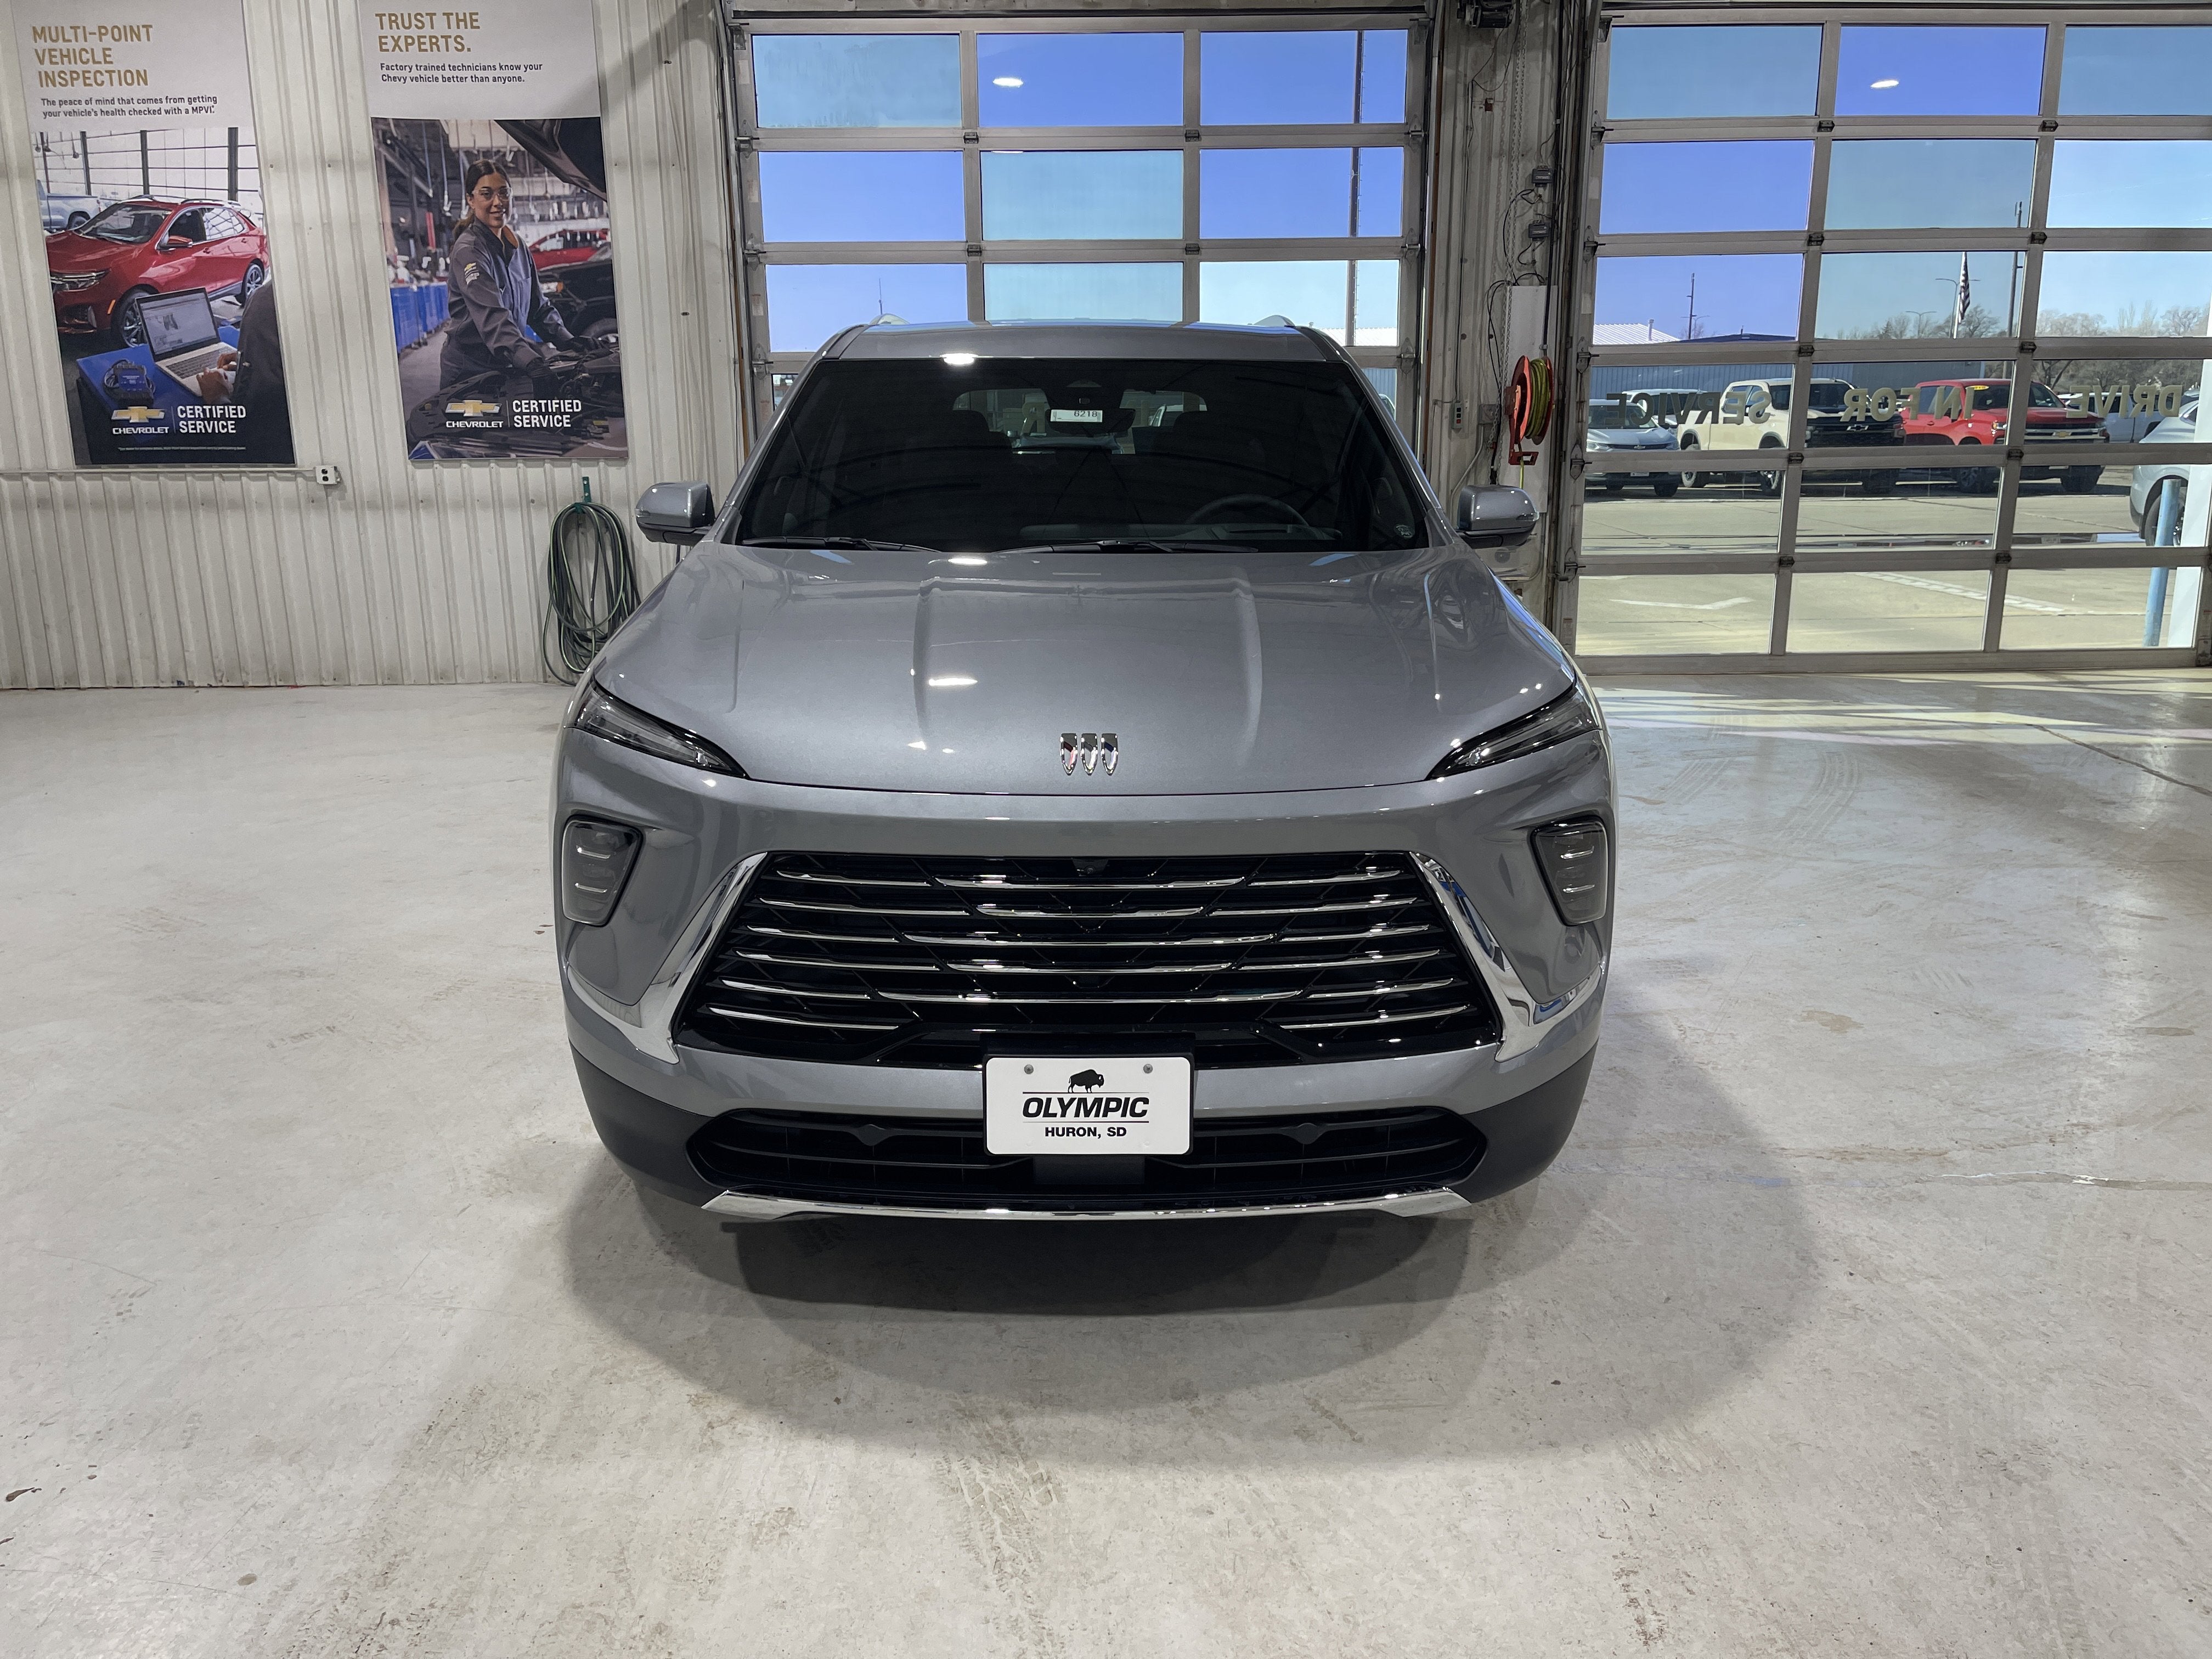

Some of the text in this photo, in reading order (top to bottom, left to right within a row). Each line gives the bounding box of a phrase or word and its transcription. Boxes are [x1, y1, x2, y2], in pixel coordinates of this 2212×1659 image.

[375, 12, 481, 30] TRUST THE
[32, 25, 153, 43] MULTI-POINT
[378, 35, 472, 53] EXPERTS.
[35, 48, 114, 65] VEHICLE
[380, 63, 543, 72] Factory trained technicians know your
[38, 69, 149, 88] INSPECTION
[381, 74, 525, 84] Chevy vehicle better than anyone.
[41, 98, 56, 106] The
[59, 98, 82, 108] peace
[84, 97, 93, 105] of
[95, 97, 115, 105] mind
[117, 97, 135, 105] that
[188, 95, 217, 105] getting
[43, 110, 61, 119] your
[63, 109, 98, 117] vehicle's
[100, 108, 126, 116] health
[128, 107, 161, 116] checked
[164, 106, 182, 115] with
[177, 405, 246, 419] CERTIFIED
[512, 400, 582, 413] CERTIFIED
[179, 421, 236, 433] SERVICE
[514, 415, 571, 428] SERVICE
[112, 426, 170, 435] CHEVROLET
[1023, 1097, 1149, 1118] OLYMPIC
[1045, 1127, 1127, 1139] HURON, SD
